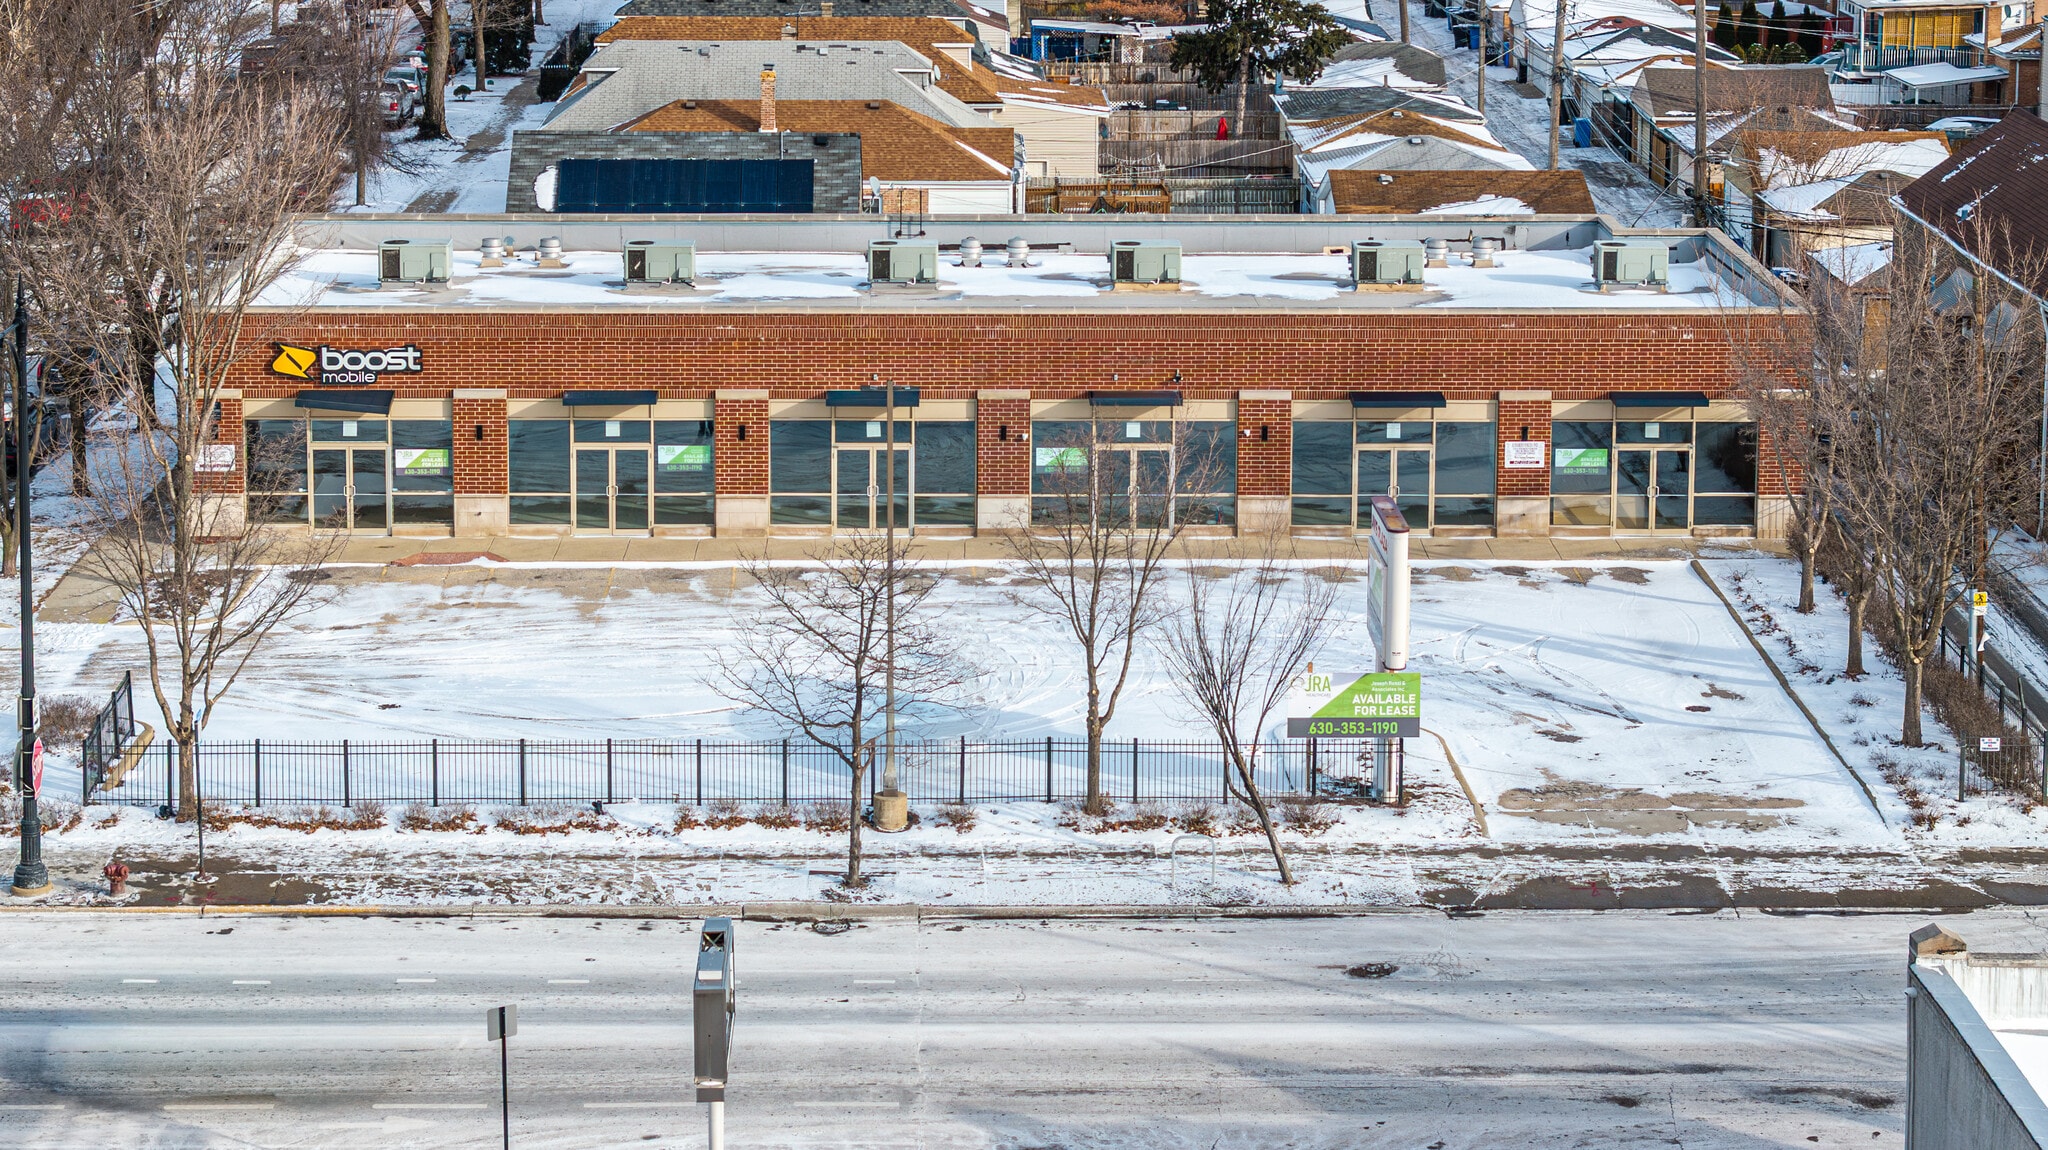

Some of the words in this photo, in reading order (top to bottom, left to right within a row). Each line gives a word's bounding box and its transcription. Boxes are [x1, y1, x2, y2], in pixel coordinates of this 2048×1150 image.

[321, 346, 421, 371] boost
[322, 371, 375, 383] mobile
[1304, 675, 1331, 692] JRA
[1352, 694, 1416, 704] AVAILABLE
[1354, 705, 1377, 716] FOR
[1379, 705, 1416, 716] LEASE
[1309, 721, 1398, 735] 630-353-1190
